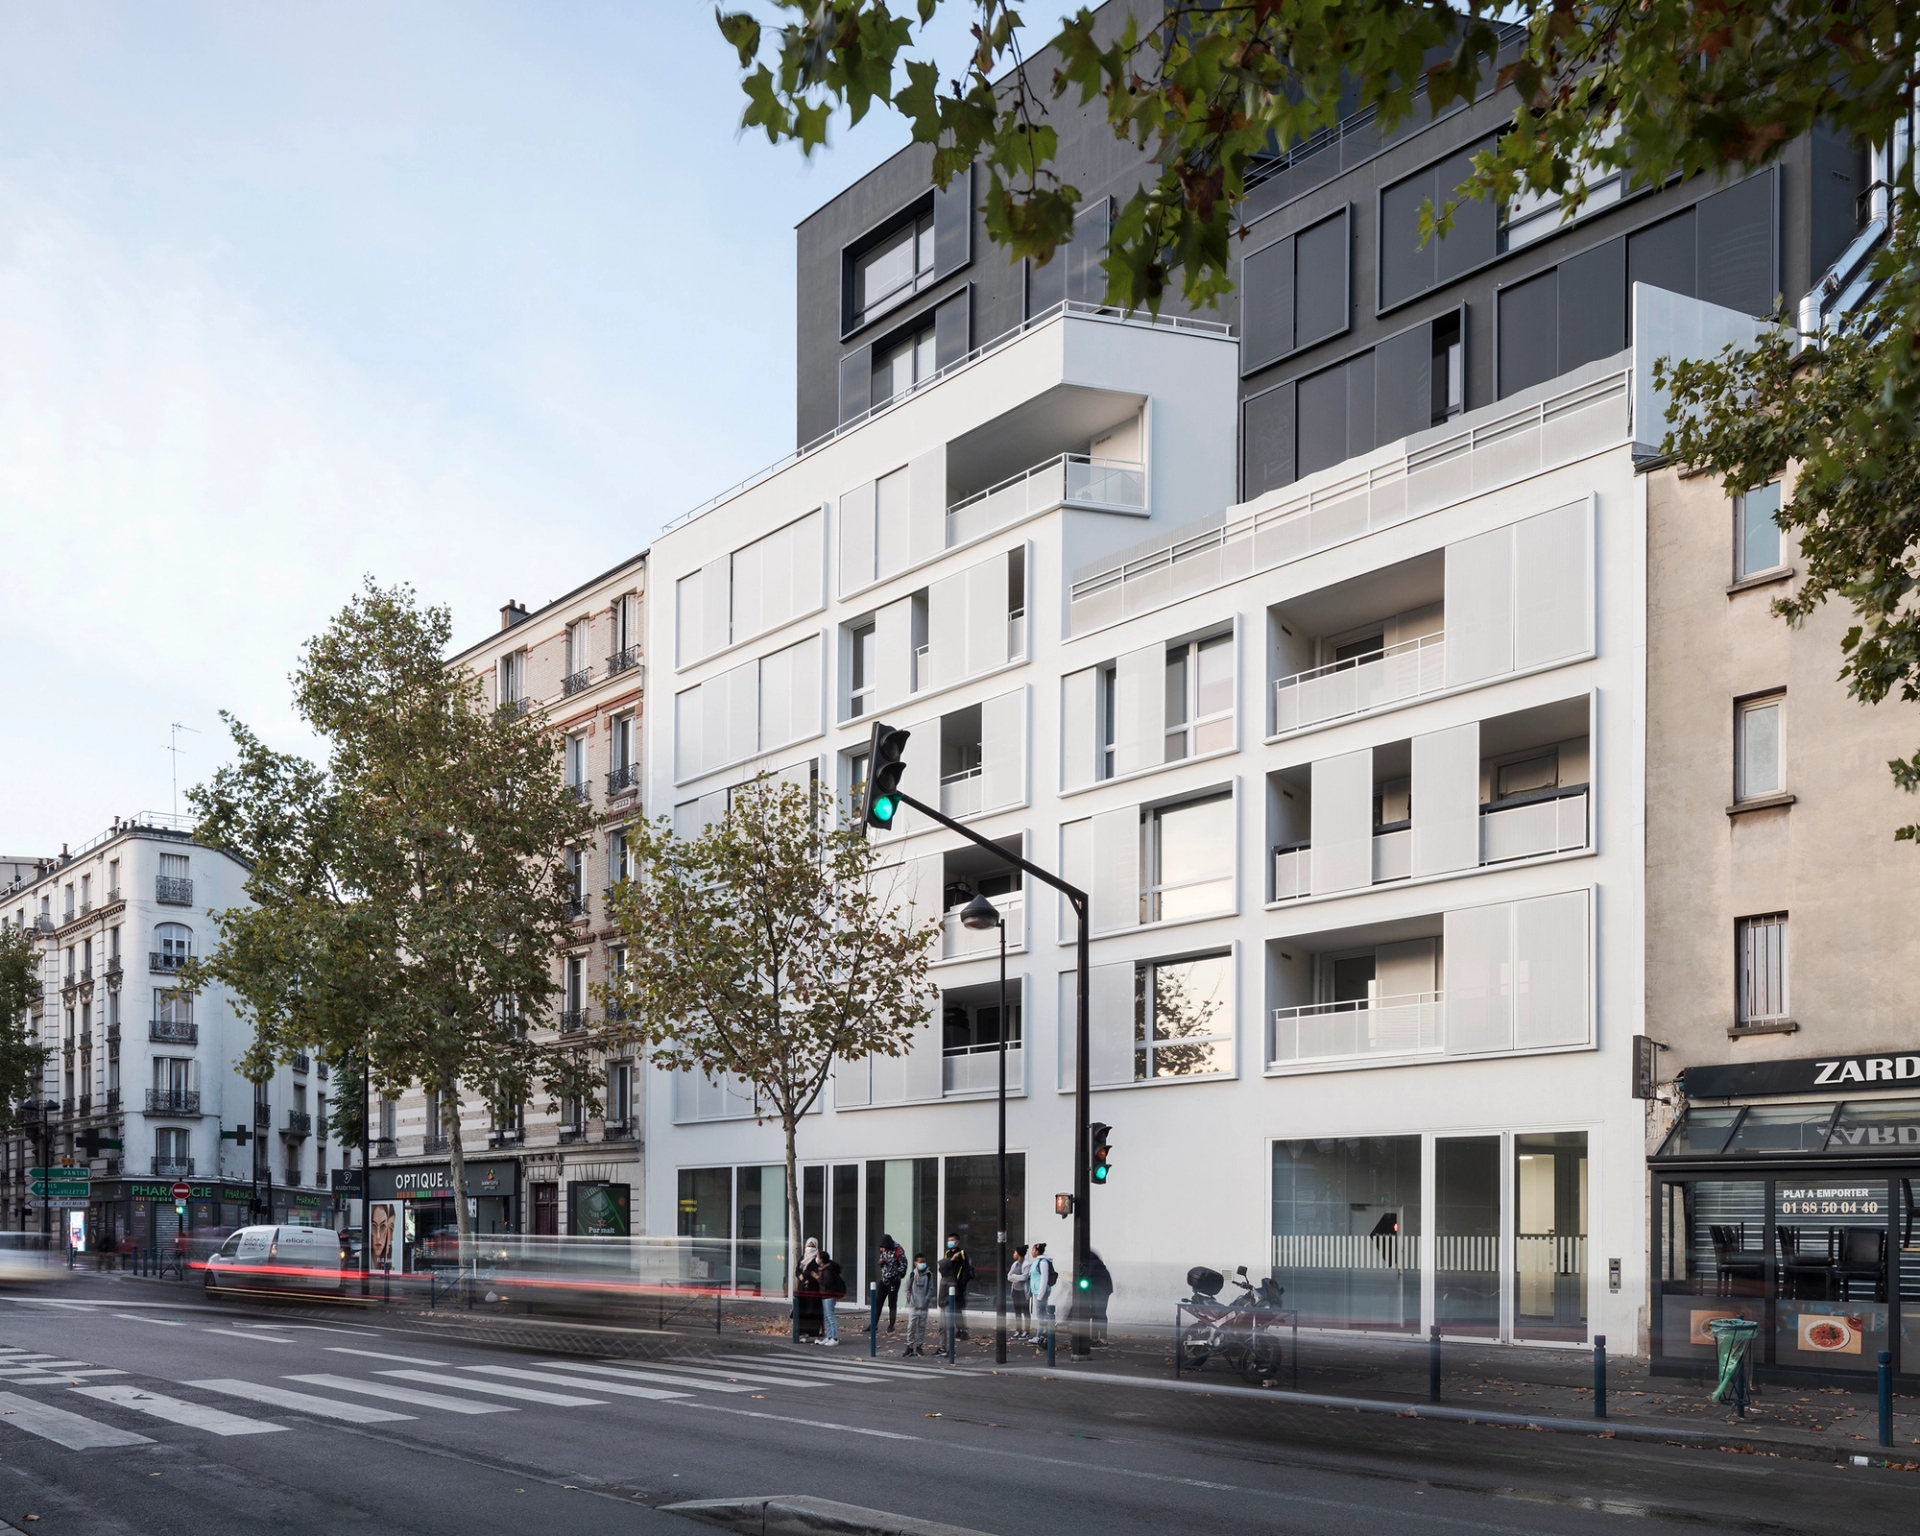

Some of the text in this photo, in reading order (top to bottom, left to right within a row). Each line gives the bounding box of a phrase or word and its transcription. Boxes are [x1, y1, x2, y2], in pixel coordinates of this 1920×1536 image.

[1814, 1057, 1920, 1084] ZARD
[395, 1172, 444, 1189] OPTIQUE
[131, 1185, 212, 1197] PHARCIE
[1783, 1188, 1869, 1198] PLAT A EMPORTER
[1782, 1201, 1878, 1214] 01 88 50 04 40
[588, 1226, 615, 1234] Pur malt
[244, 1236, 260, 1247] elior
